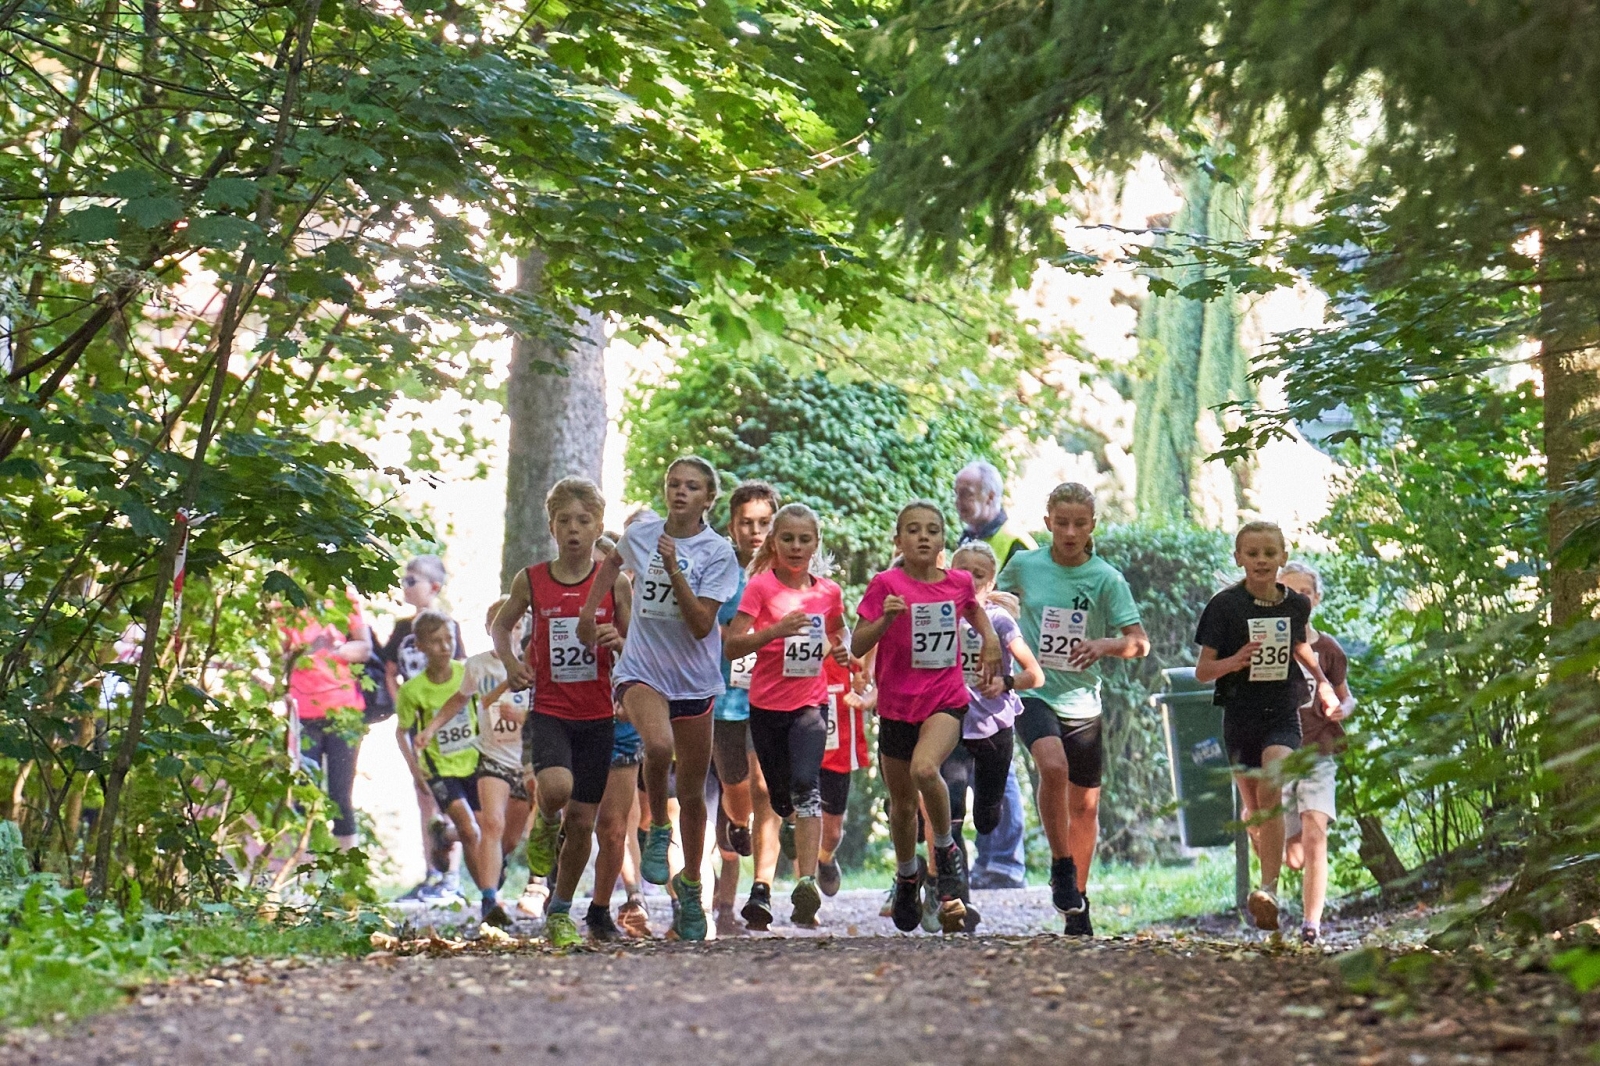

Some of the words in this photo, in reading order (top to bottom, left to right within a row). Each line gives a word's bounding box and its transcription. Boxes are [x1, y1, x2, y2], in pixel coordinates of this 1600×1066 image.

[642, 580, 679, 605] 37
[1071, 596, 1089, 611] 14
[553, 634, 569, 642] CUP
[913, 630, 956, 653] 377
[551, 646, 596, 667] 326
[785, 642, 824, 662] 454
[1251, 645, 1289, 665] 336
[437, 724, 472, 745] 386
